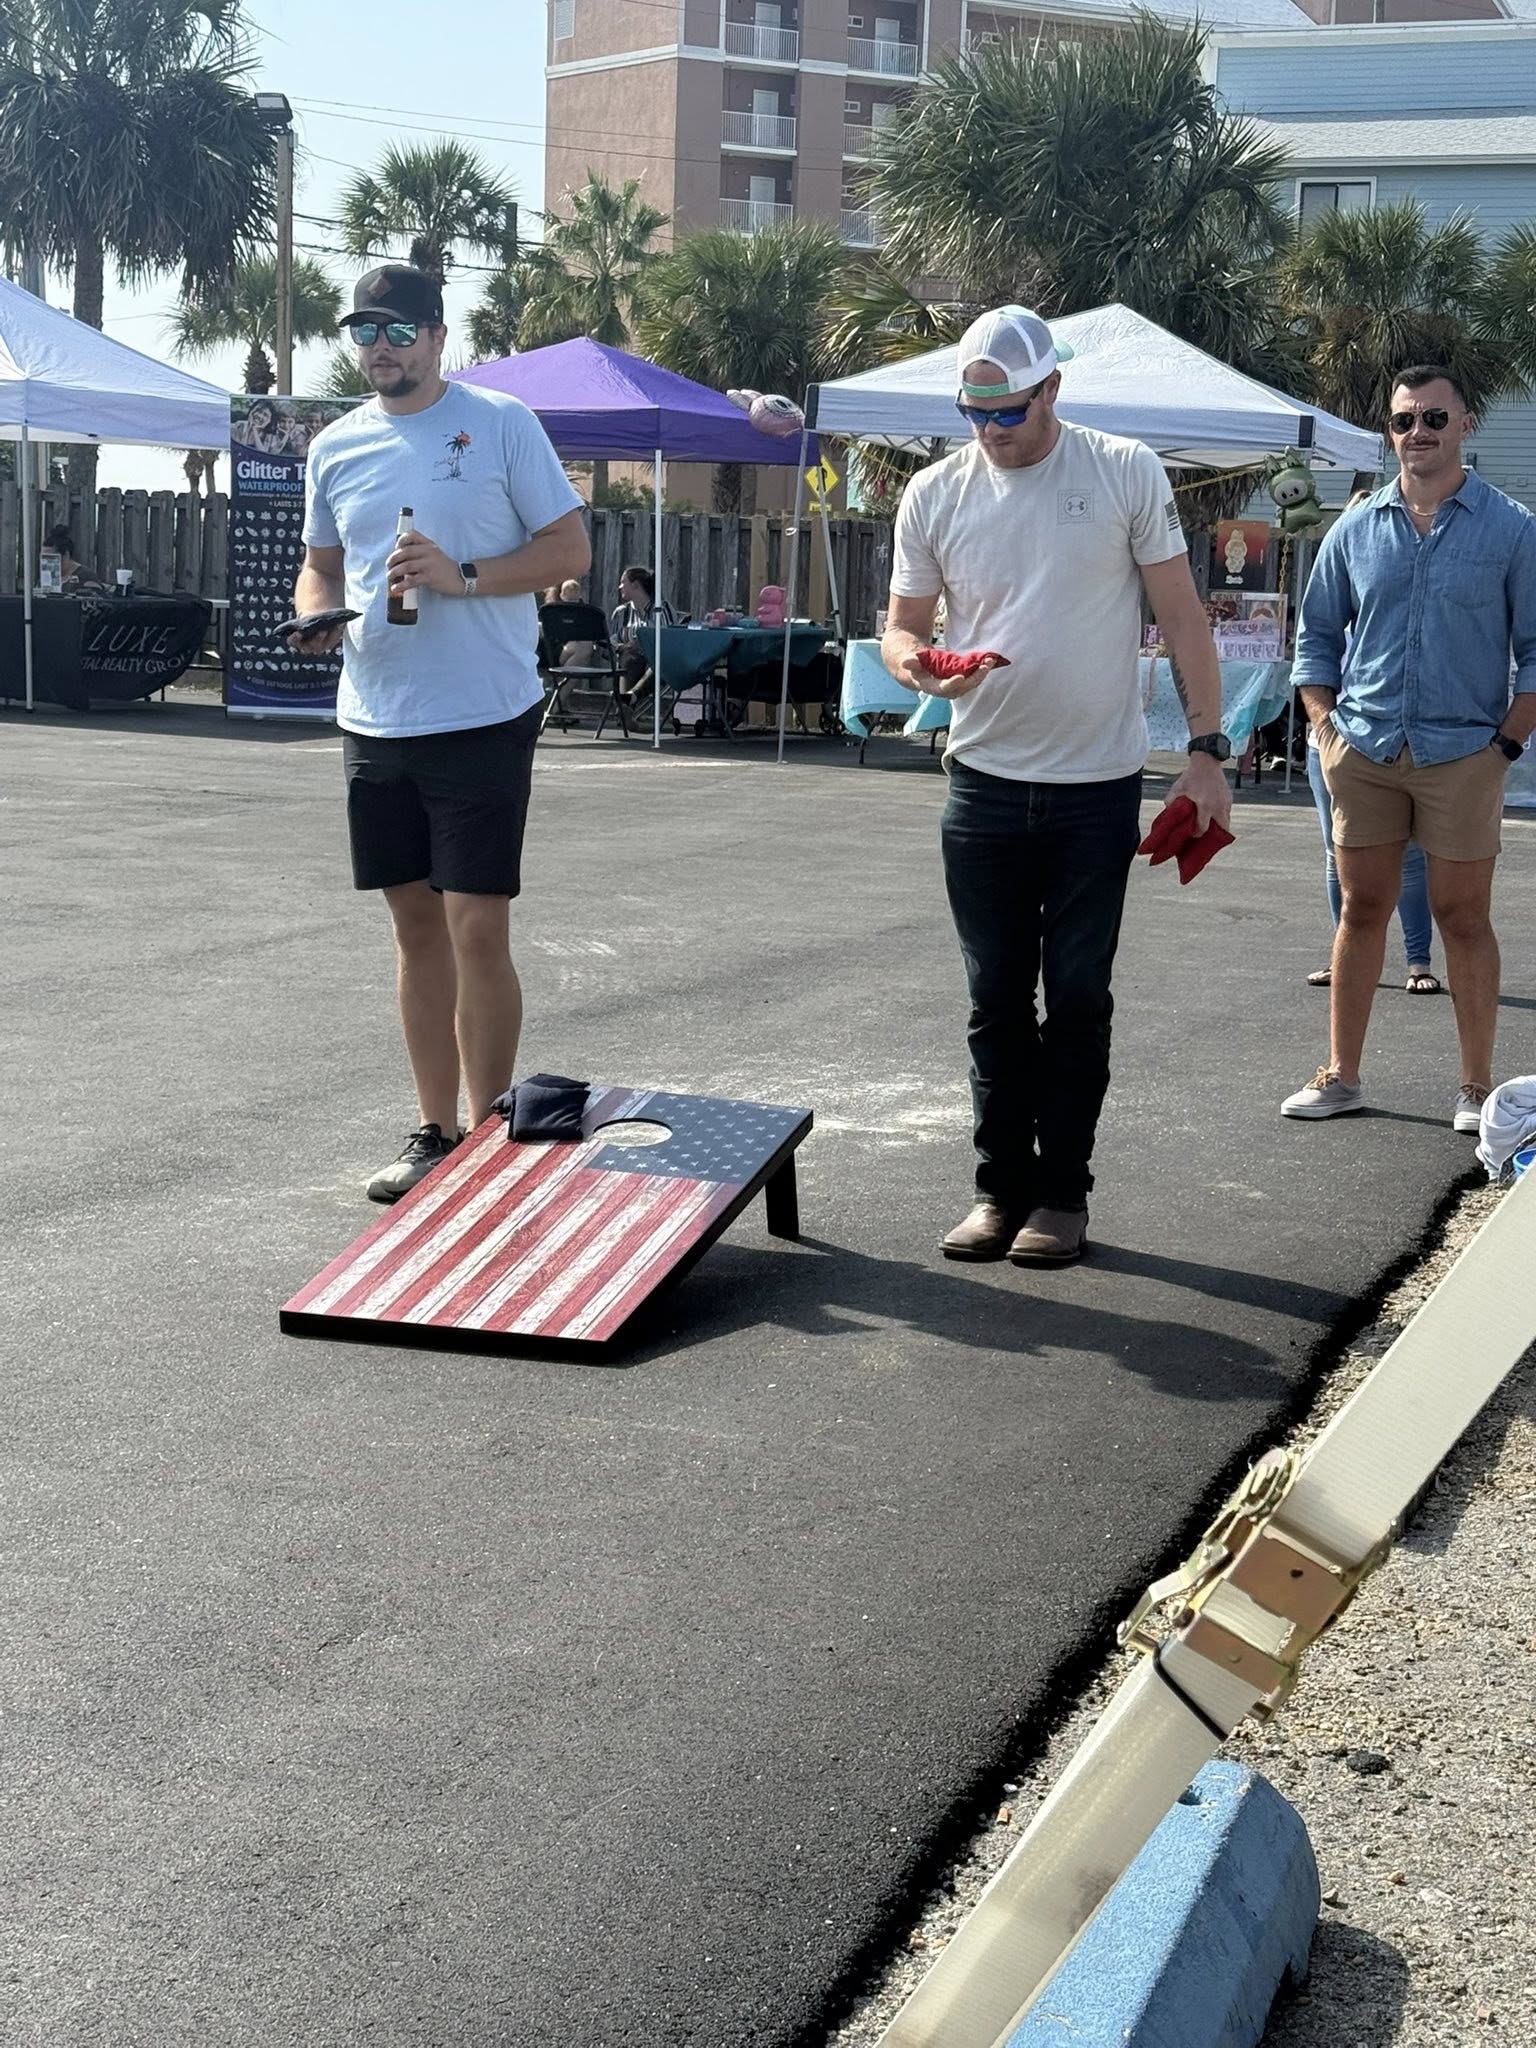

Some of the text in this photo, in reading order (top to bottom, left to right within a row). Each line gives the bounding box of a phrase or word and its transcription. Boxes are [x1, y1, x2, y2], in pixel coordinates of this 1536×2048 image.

[237, 460, 291, 480] Glitter
[238, 480, 303, 492] WATERPROOF
[88, 625, 176, 654] LUXE
[100, 656, 143, 672] REALTY
